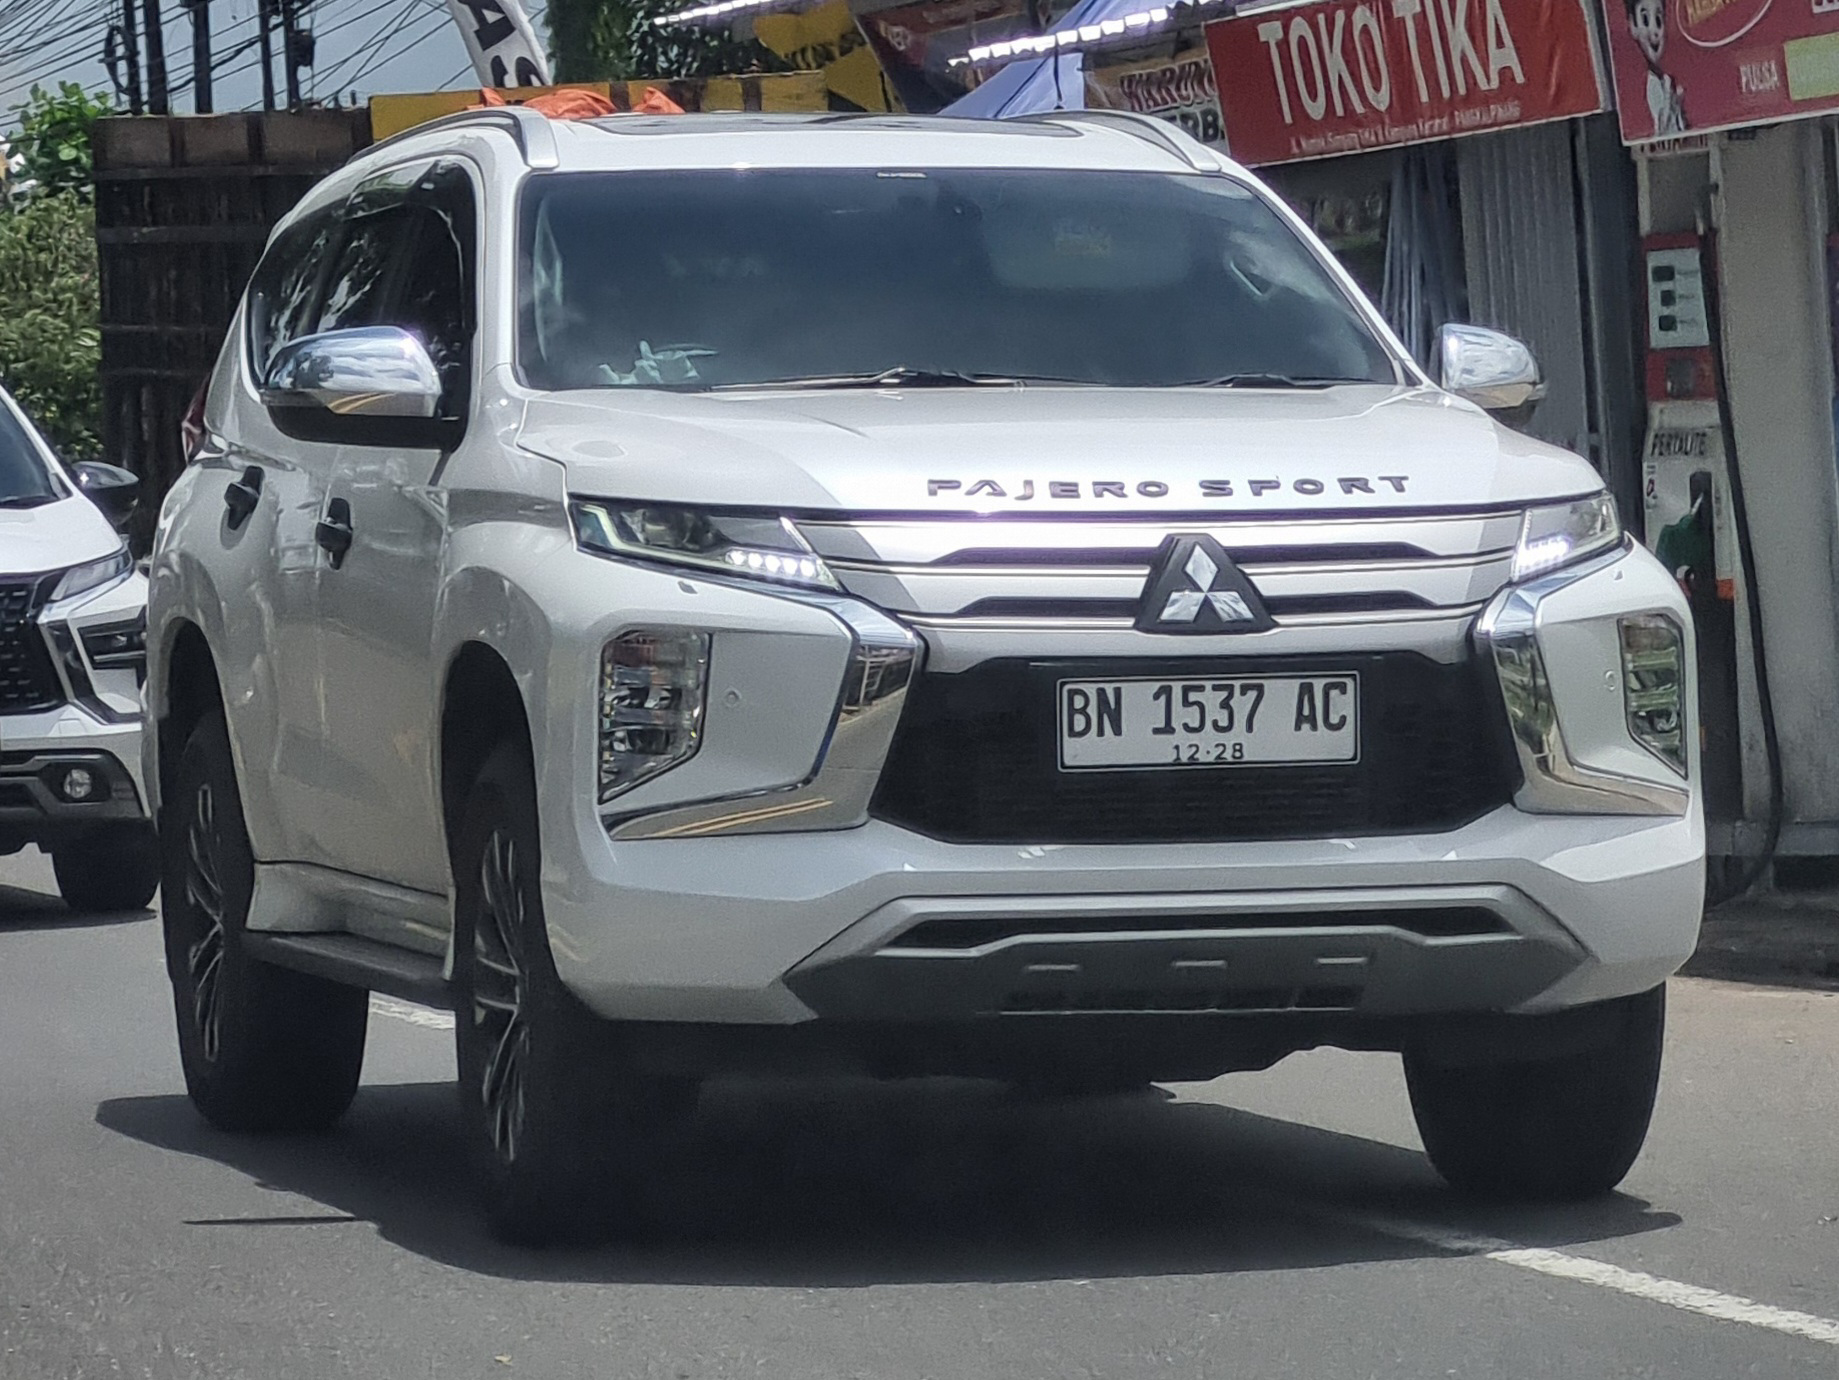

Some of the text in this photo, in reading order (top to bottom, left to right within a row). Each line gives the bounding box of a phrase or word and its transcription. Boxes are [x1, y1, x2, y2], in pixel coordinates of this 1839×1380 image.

[1257, 0, 1525, 124] TOKO TIKA
[928, 475, 1410, 500] PAJERO SPORT
[1066, 681, 1349, 738] BN 1537 AC
